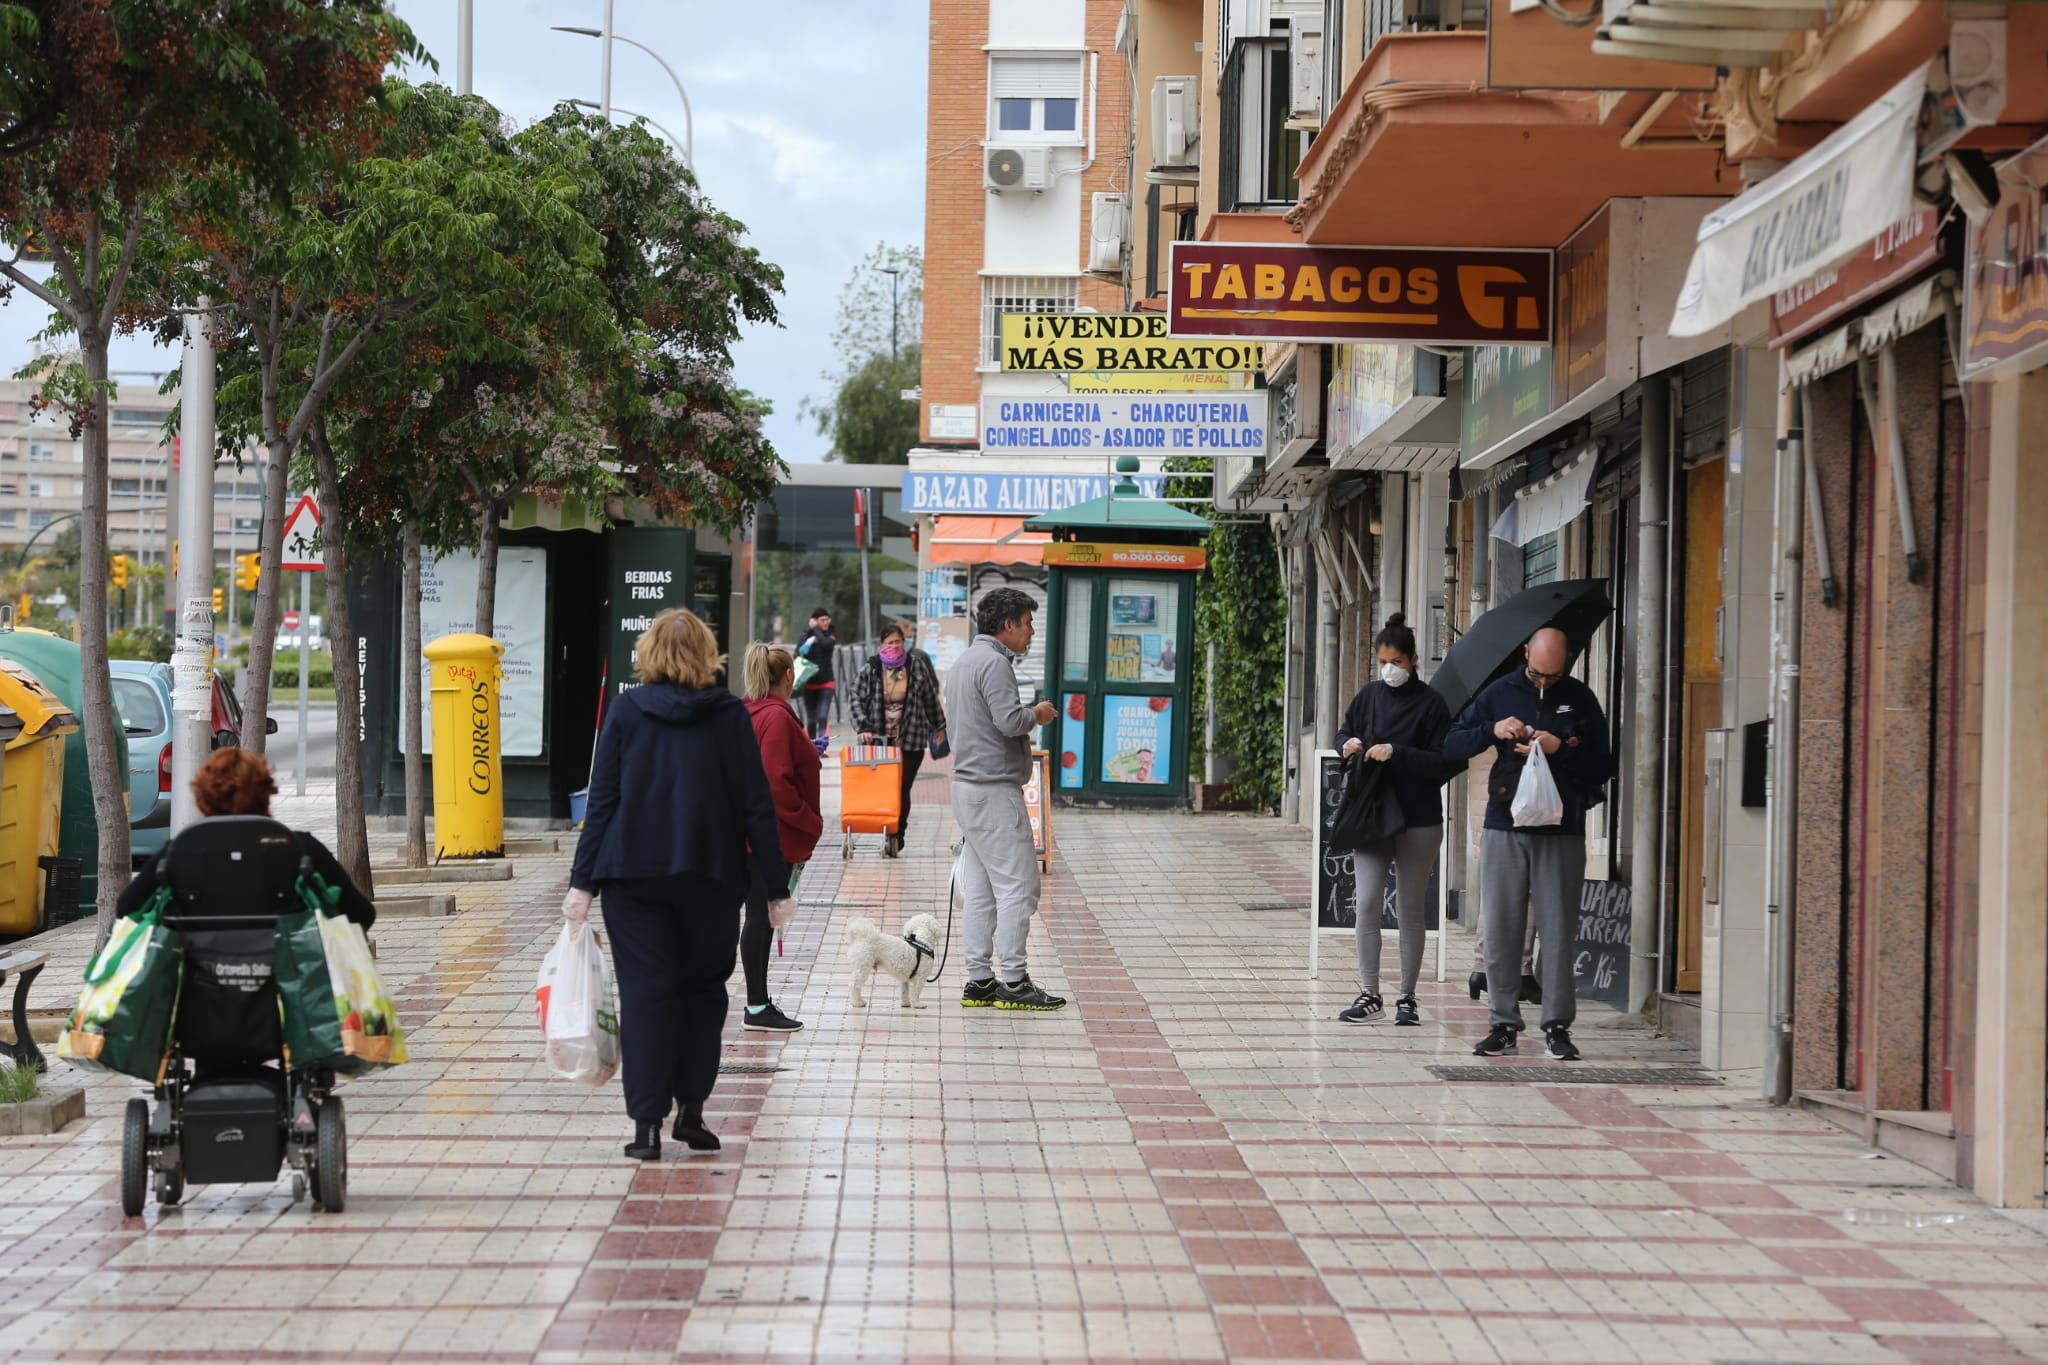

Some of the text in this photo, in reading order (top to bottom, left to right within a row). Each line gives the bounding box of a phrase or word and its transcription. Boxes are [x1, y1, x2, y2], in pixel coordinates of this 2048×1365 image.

[1181, 262, 1439, 305] TABACOS
[1008, 341, 1264, 370] MÁS BARATO!!
[1000, 402, 1101, 423] CARNICERIA
[1130, 403, 1249, 423] CHARCUTERIA
[1173, 428, 1194, 448] DE
[1201, 428, 1263, 448] POLLOS
[913, 476, 988, 509] BAZAR
[625, 571, 672, 584] BEBIDAS
[358, 636, 367, 742] REVISTAS
